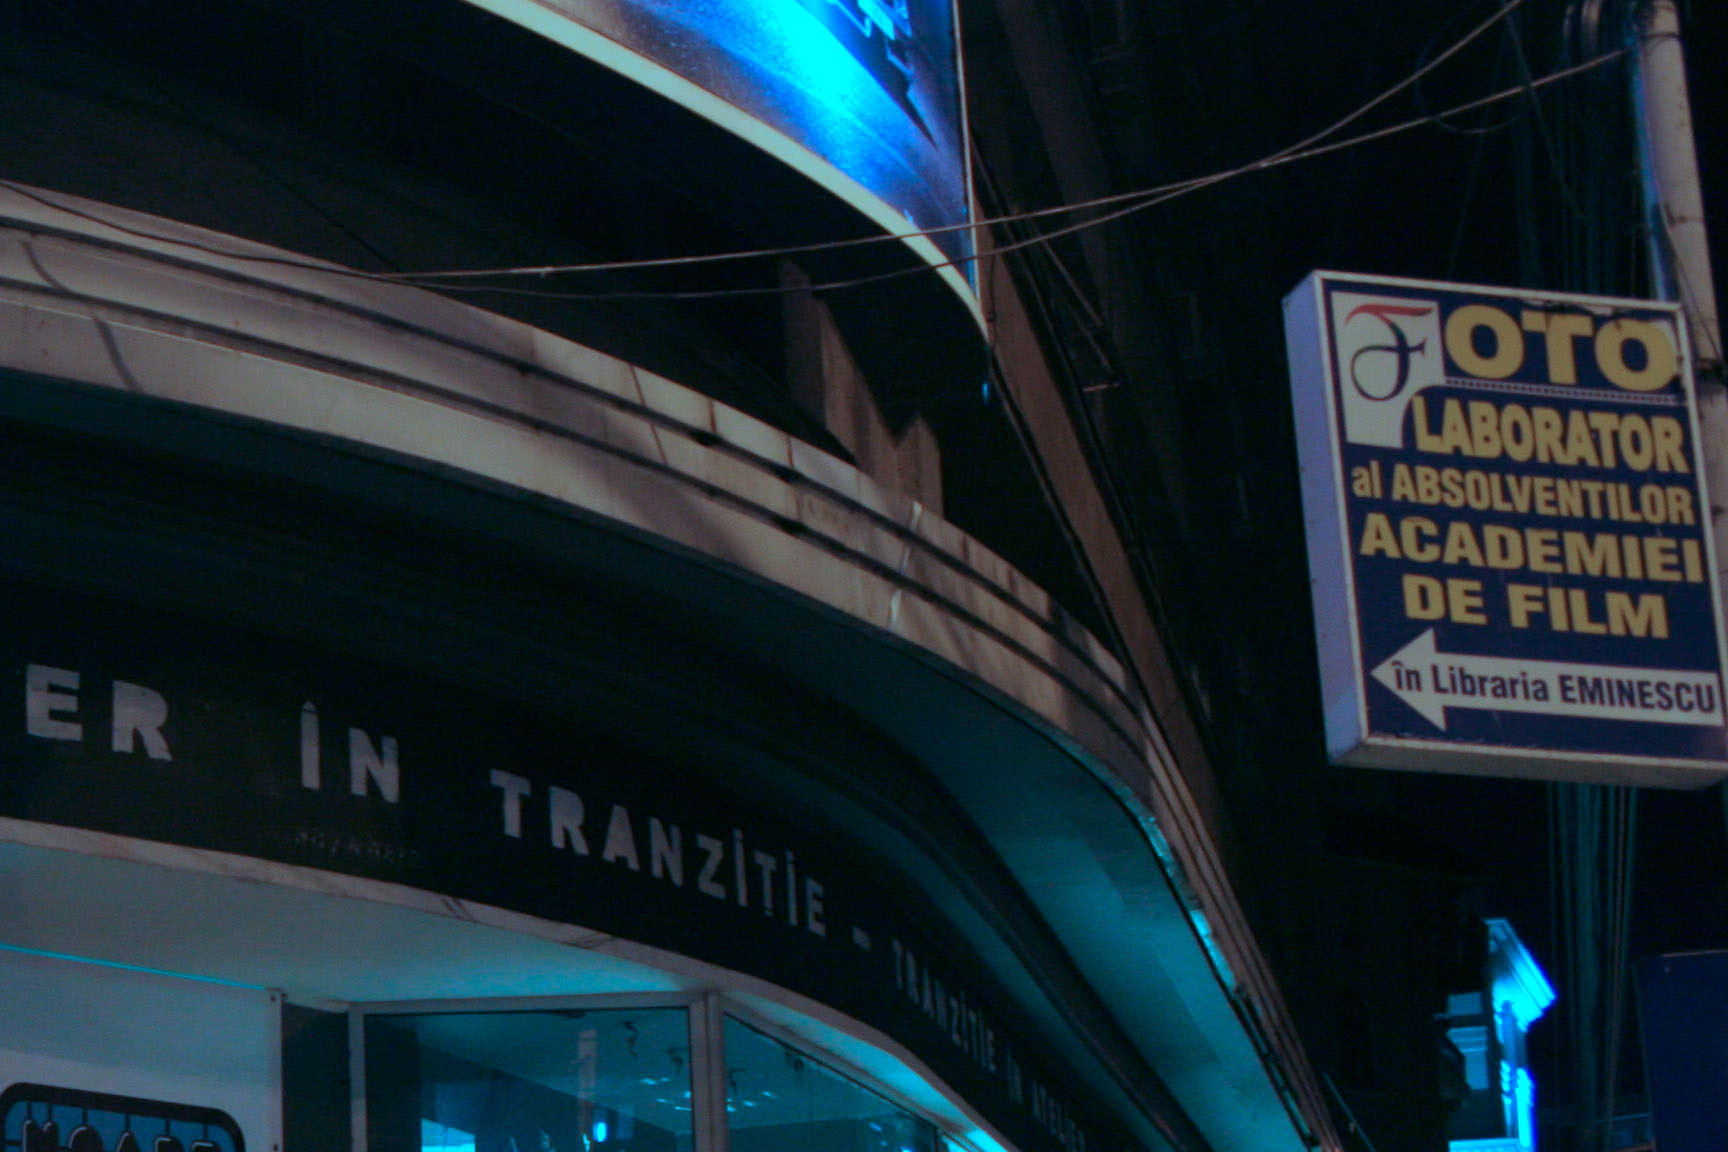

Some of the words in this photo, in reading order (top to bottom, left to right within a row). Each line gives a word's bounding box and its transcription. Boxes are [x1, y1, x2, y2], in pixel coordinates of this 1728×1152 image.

[1412, 394, 1690, 473] LABORATOR
[1352, 461, 1382, 498] al
[1392, 464, 1695, 525] ABSOLVENTILOR
[1360, 513, 1703, 582] ACADEMIEI
[1402, 575, 1488, 625] DE
[1508, 584, 1670, 639] FILM
[1430, 665, 1549, 701] Libraria
[1558, 675, 1715, 713] EMINESCU
